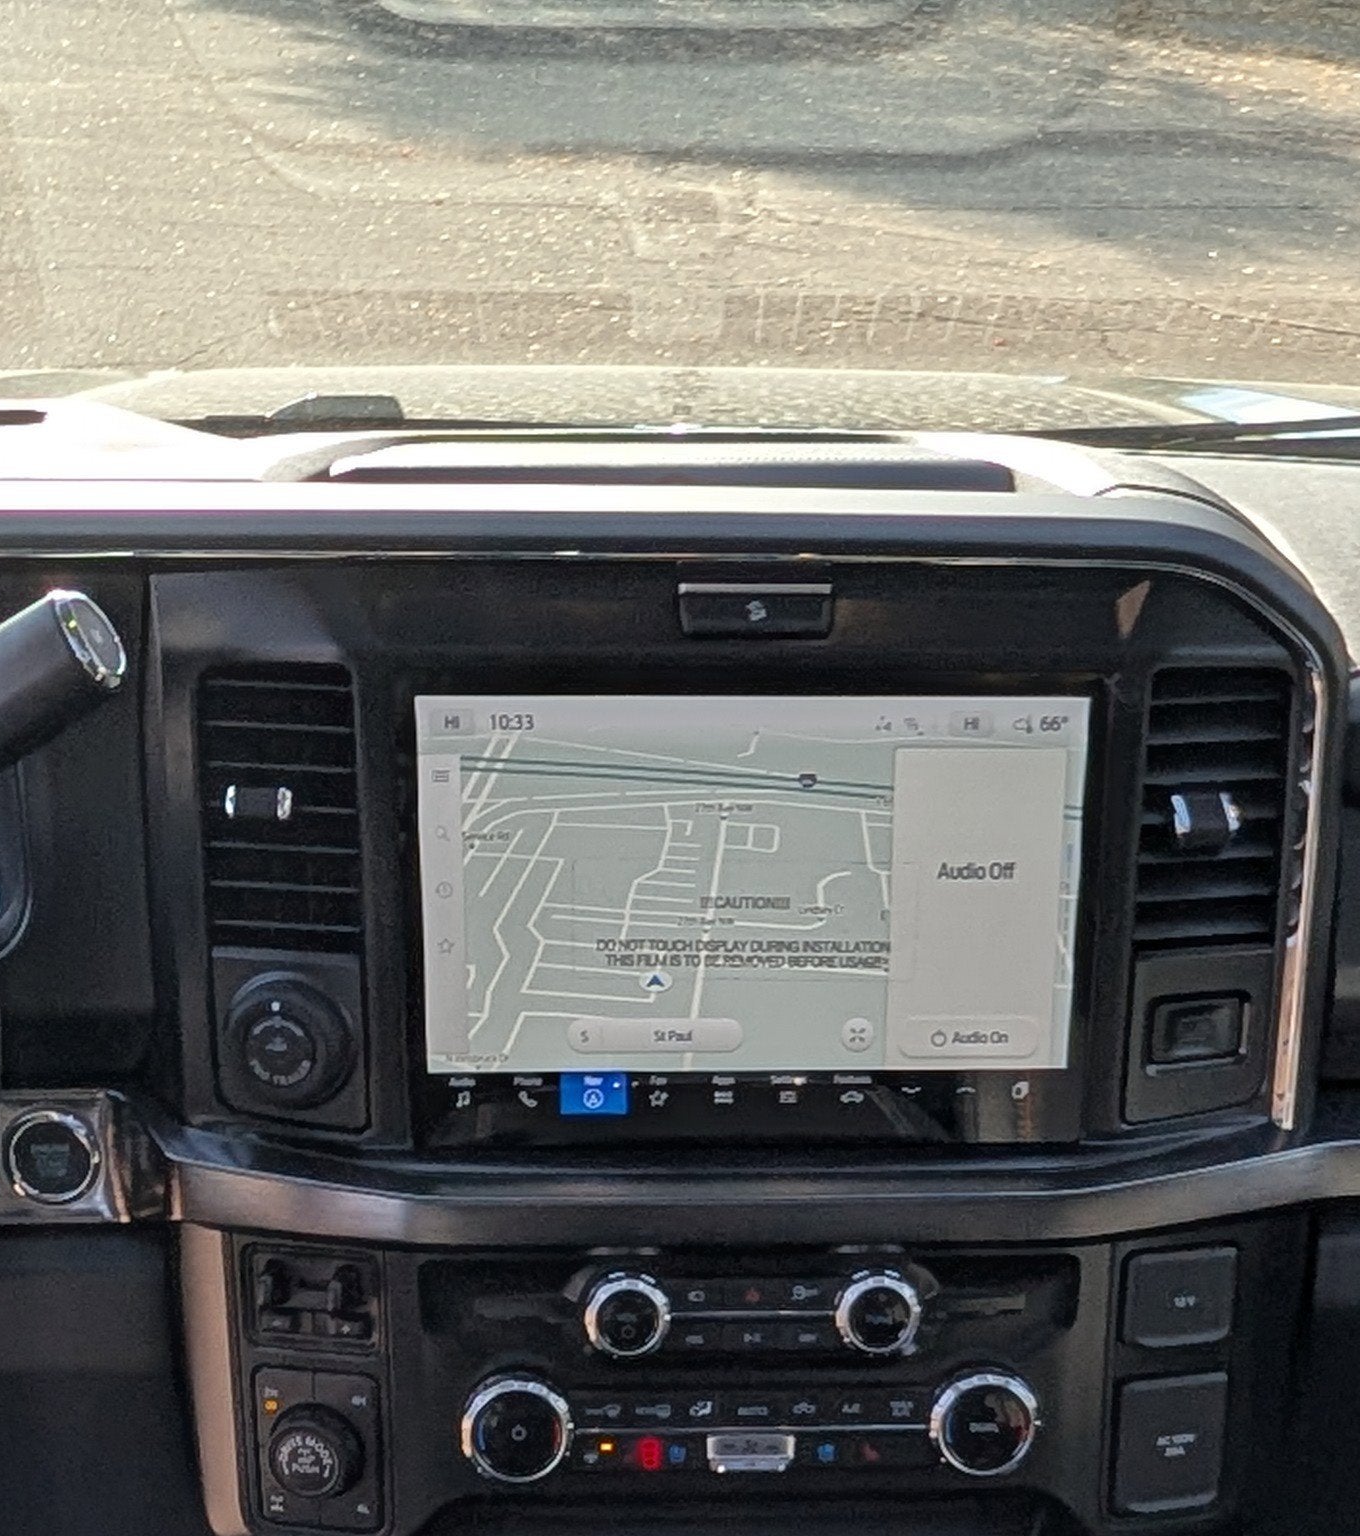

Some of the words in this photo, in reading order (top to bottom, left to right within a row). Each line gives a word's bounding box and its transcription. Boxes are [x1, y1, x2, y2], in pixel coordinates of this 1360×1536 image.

[444, 716, 460, 729] HI
[490, 713, 535, 731] 10:33
[963, 717, 980, 730] HI
[937, 862, 986, 879] Audio
[989, 862, 1017, 879] Off
[596, 939, 618, 951] DO
[620, 939, 644, 951] NOT
[648, 940, 691, 952] TOUCH
[697, 940, 749, 952] DISPLAY
[751, 940, 800, 953] DURING
[802, 941, 890, 953] INSTALLATION
[605, 954, 635, 966] THIS
[636, 954, 669, 966] FILM
[670, 954, 681, 966] IS
[682, 954, 701, 966] TO
[653, 1030, 668, 1042] St
[670, 1029, 693, 1042] Paul
[951, 1031, 987, 1044] Audio
[990, 1031, 1009, 1044] On
